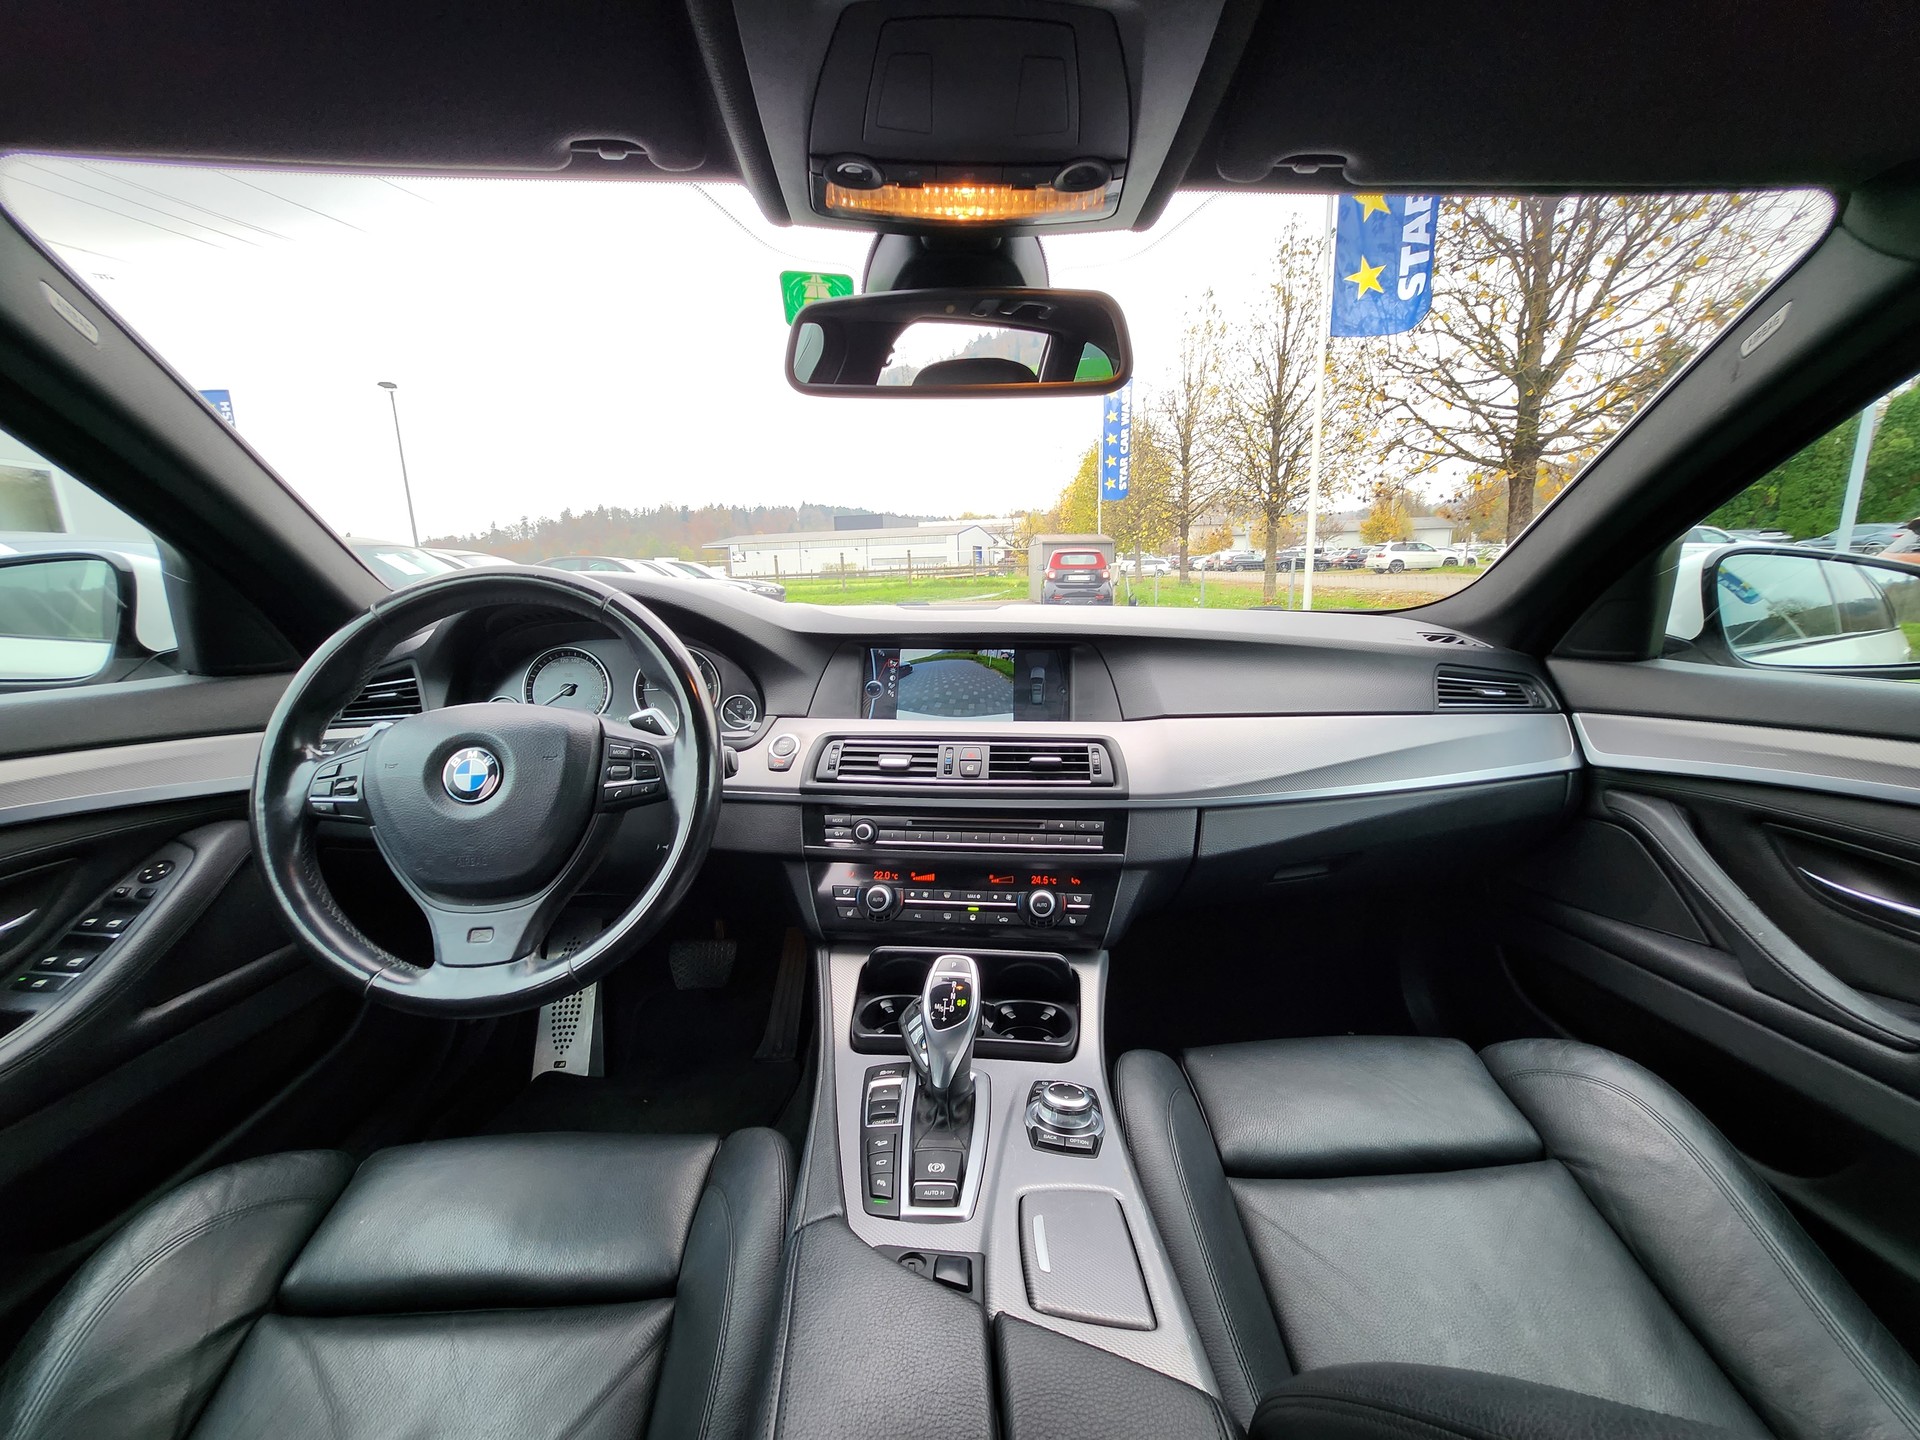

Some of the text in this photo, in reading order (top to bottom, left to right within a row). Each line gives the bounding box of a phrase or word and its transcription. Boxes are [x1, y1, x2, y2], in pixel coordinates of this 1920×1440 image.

[1120, 428, 1130, 455] CAR
[1118, 457, 1129, 491] STAR
[450, 750, 495, 768] BMW
[873, 871, 890, 880] 22.0
[1031, 875, 1049, 885] 24.5
